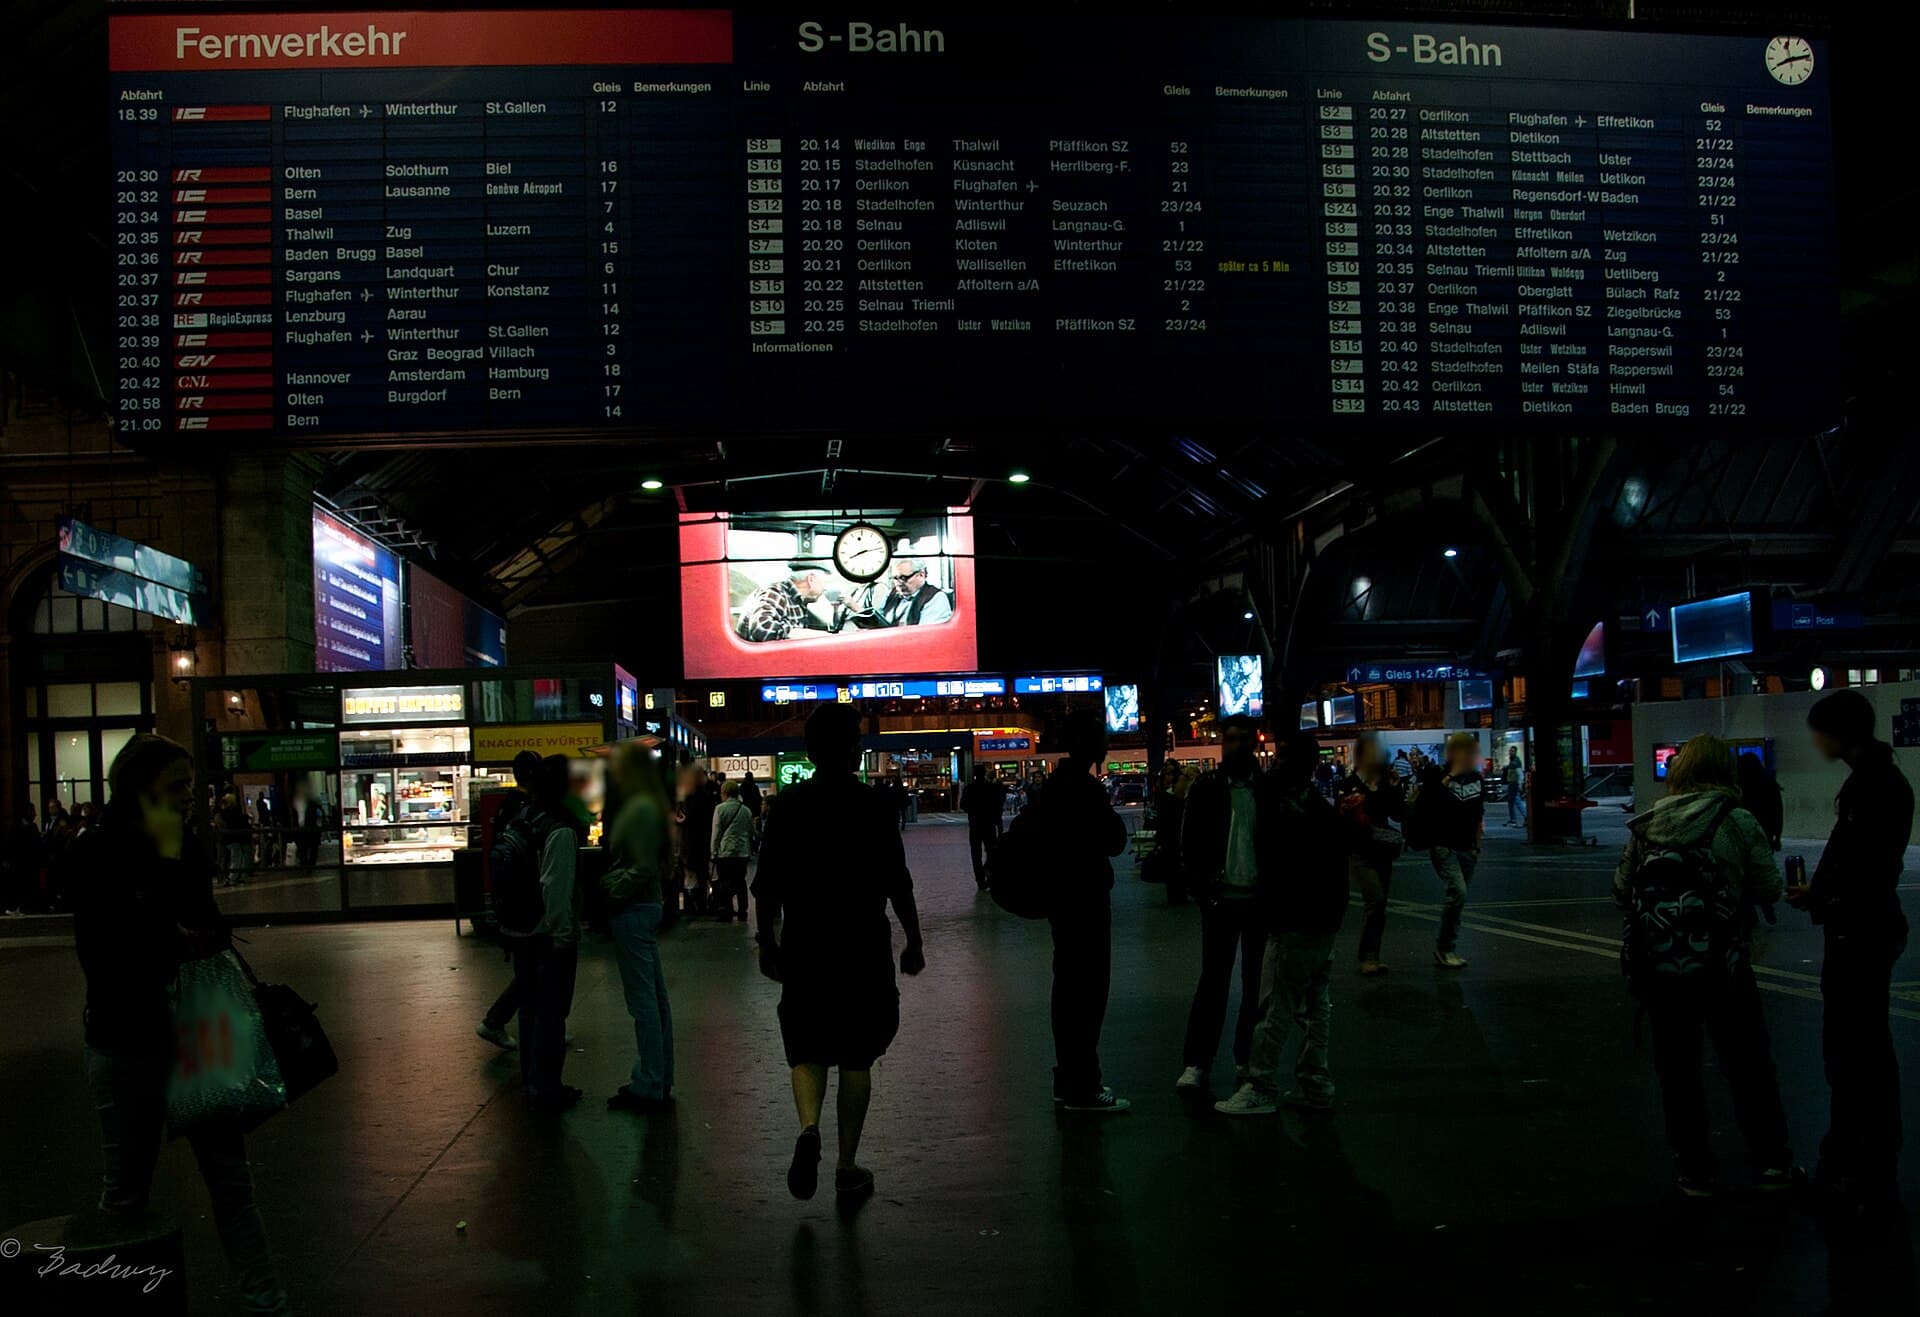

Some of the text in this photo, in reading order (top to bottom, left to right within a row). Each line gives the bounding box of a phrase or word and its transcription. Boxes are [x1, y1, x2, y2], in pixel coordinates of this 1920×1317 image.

[177, 25, 406, 58] Fernverkehr
[798, 22, 944, 52] S-Bahn
[1367, 32, 1501, 66] S-Bahn
[121, 90, 162, 100] Abfahrt
[593, 82, 711, 93] Gleis Bemerkungen
[744, 81, 1287, 99] Linie Abfahrt Gleis Bemerkungen
[285, 102, 546, 119] Flughafen Winterthur St.Gallen
[1317, 89, 1812, 117] Linie Abfahrt Gleis Bemerkungen
[1420, 110, 1654, 128] Oerlikon Flughafen Effretikon
[1421, 129, 1559, 144] Altstetten Dietikon
[953, 140, 1128, 152] Thalwil Pfäffikon SZ
[1422, 148, 1631, 165] Stadelhofen Stettbach Uster
[285, 163, 511, 179] Olten Solothurn Biel
[856, 160, 933, 170] Stadelhofen
[954, 160, 1014, 171] Küsnacht
[1423, 167, 1645, 184] Stadelhofen Uetikon
[285, 188, 316, 199] Bern
[386, 186, 450, 197] Lausanne
[856, 179, 1017, 192] Oerlikon Flughafen
[1424, 187, 1638, 203] Oerlikon Regensdorf-W Baden
[857, 199, 1107, 211] Stadelhofen Winterthur Seuzach
[1424, 206, 1504, 219] Enge Thalwil
[285, 208, 322, 220] Basel
[285, 224, 530, 240] Thalwil Zug Luzern
[857, 219, 902, 230] Selnau
[956, 219, 1005, 230] Adliswil
[1425, 225, 1656, 242] Stadelhofen Effretikon Wetzikon
[857, 240, 1122, 251] Oerlikon Kloten Winterthur
[1427, 244, 1626, 262] Altstetten Affoltern a/A Zug
[285, 246, 423, 261] Baden Brugg Basel
[858, 259, 911, 270] Oerlikon
[957, 259, 1026, 270] Wallisellen
[1054, 259, 1116, 270] Effretikon
[1263, 261, 1269, 272] 5
[1427, 264, 1658, 282] Selnau Triemli Uetliberg
[286, 264, 519, 283] Sargans Landquart Chur
[859, 279, 1039, 291] Altstetten Affoltern a/A
[1428, 283, 1679, 299] Oerlikon Oberglatt Bülach Rafz
[286, 284, 549, 303] Flughafen Winterthur Konstanz
[859, 299, 954, 311] Selnau Triemli
[1429, 303, 1681, 319] Enge Thalwil Pfäffikon SZ Ziegelbrücke
[286, 310, 345, 323] Lenzburg
[387, 308, 426, 320] Aarau
[859, 319, 1135, 331] Stadelhofen Pfäffikon SZ
[1430, 322, 1471, 333] Selnau
[1520, 324, 1566, 335] Adliswil
[286, 325, 548, 344] Flughafen Winterthur St.Gallen
[388, 346, 534, 361] Graz Beograd Villach
[753, 342, 833, 352] Informationen
[1431, 342, 1672, 357] Stadelhofen Rapperswil
[1432, 361, 1672, 376] Stadelhofen Meilen Stäfa Rapperswil
[178, 367, 549, 388] CNL Hannover Amsterdam Hamburg
[1432, 381, 1645, 394] Oerlikon Hinwil
[288, 388, 520, 405] Olten Burgdorf Bern
[1433, 400, 1689, 416] Altstetten Dietikon Baden Brugg
[288, 415, 319, 426] Bern
[1815, 616, 1835, 625] Post
[1385, 670, 1412, 680] Gleis
[479, 735, 599, 749] KNACKIGE WÜRSTE
